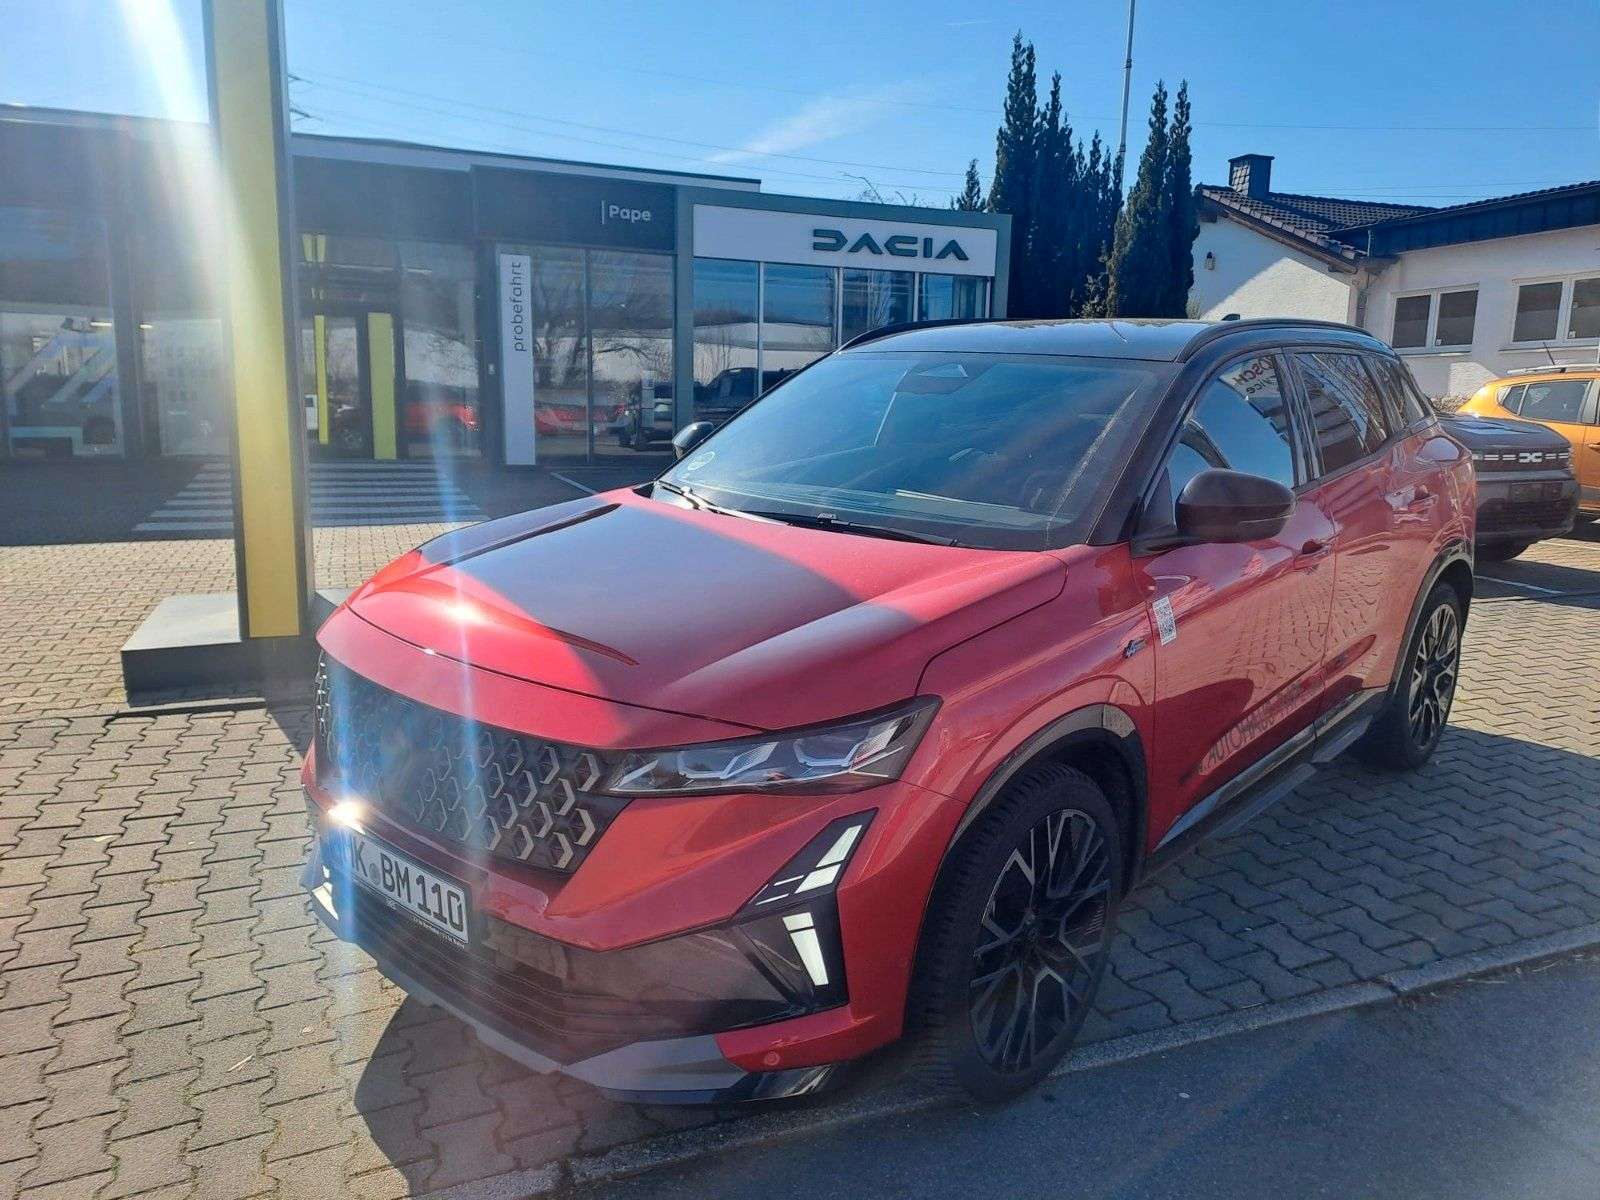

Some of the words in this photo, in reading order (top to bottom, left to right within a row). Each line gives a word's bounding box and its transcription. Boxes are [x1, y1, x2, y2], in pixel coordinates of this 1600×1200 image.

[608, 204, 651, 223] Pape
[813, 228, 969, 261] DACIA
[509, 261, 527, 352] probefahrt
[381, 853, 412, 904] BM
[415, 874, 464, 933] 110
